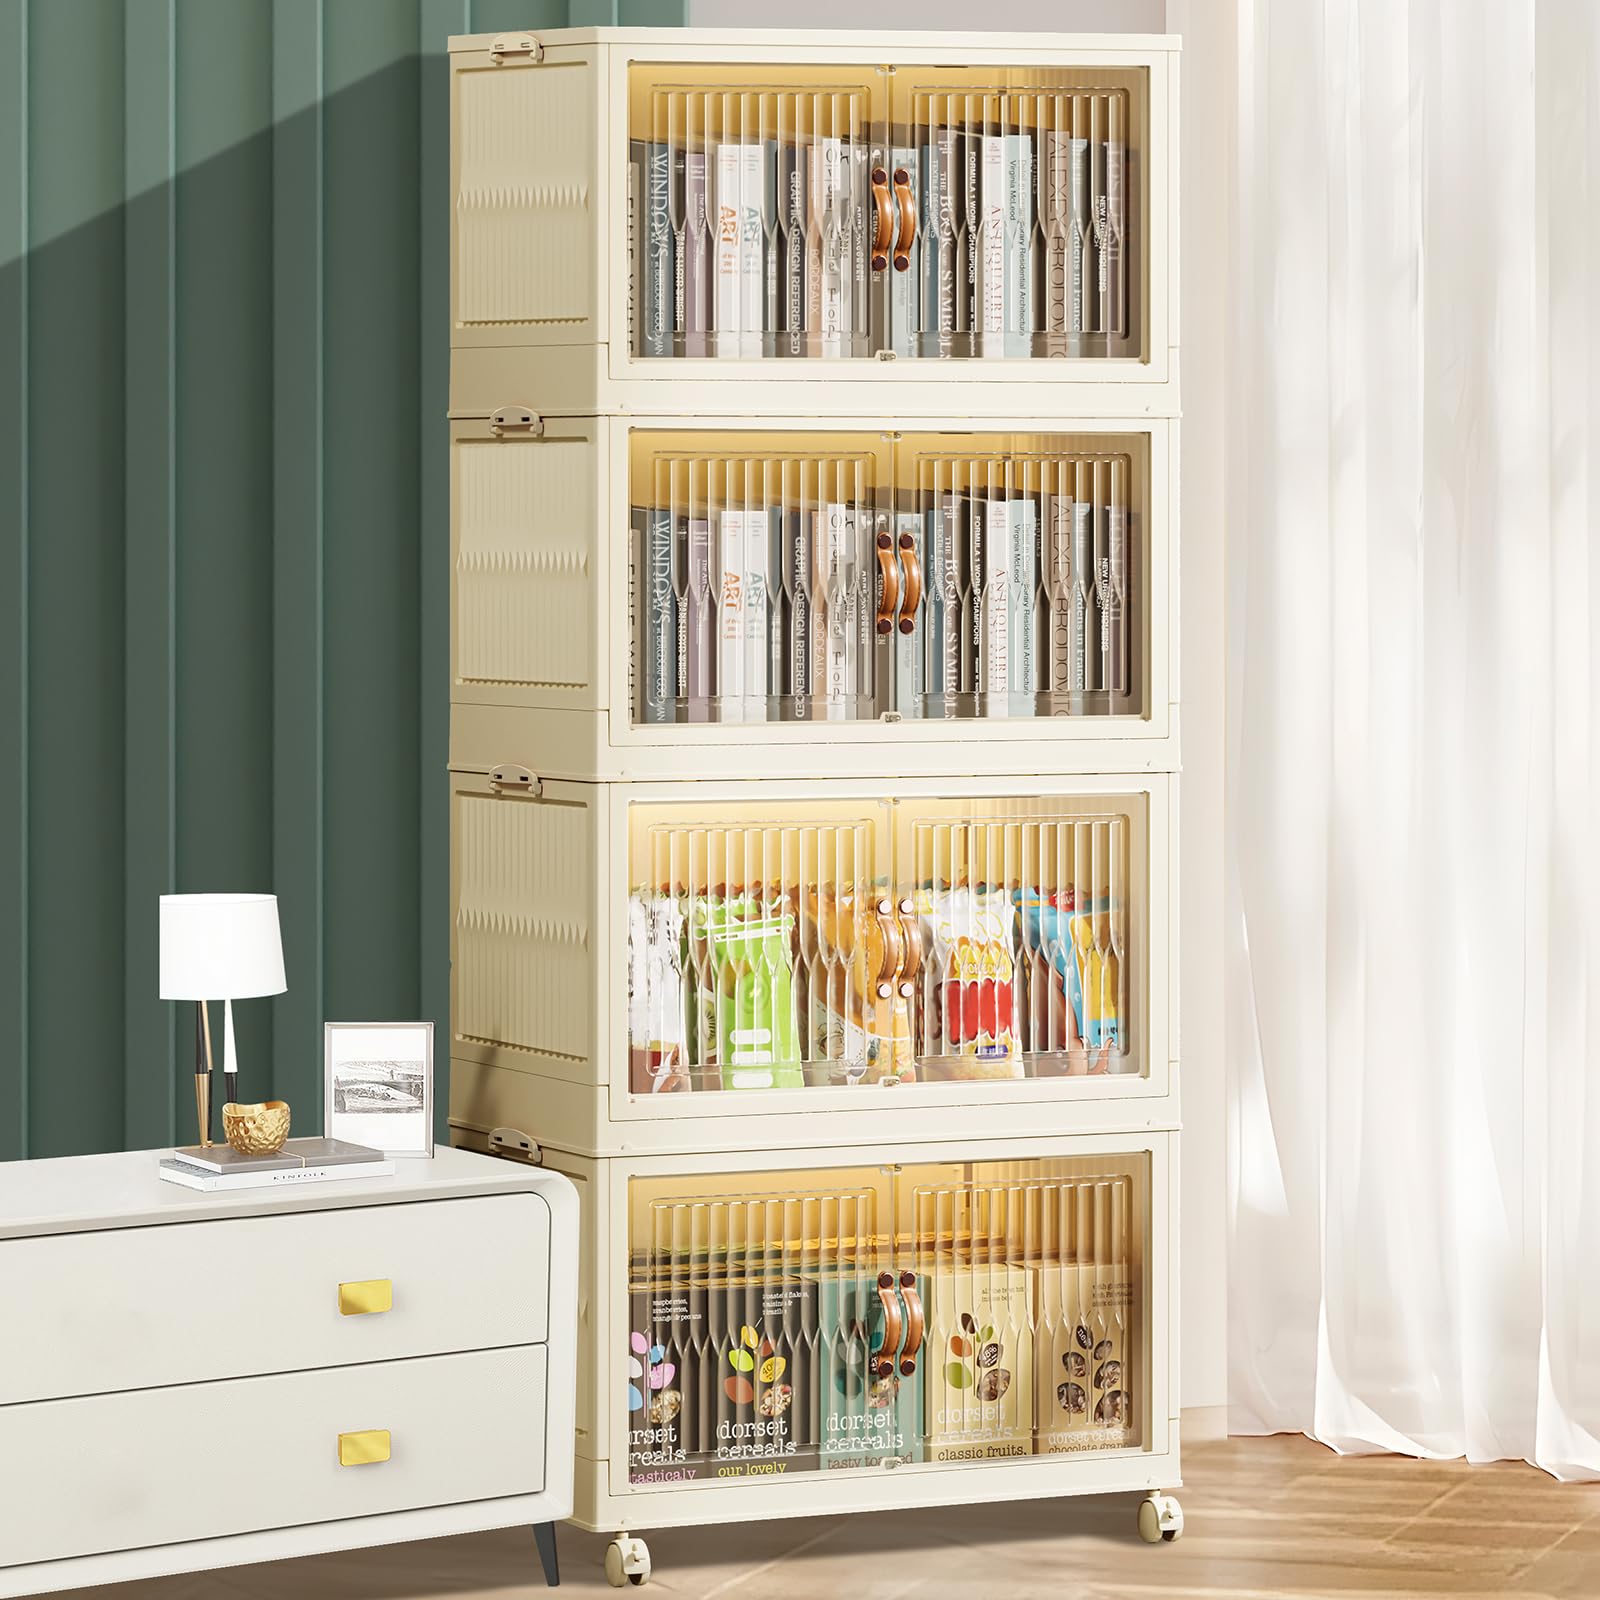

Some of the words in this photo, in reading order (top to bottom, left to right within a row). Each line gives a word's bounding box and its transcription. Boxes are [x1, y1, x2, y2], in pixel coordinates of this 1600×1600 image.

[1009, 160, 1017, 189] Virginia
[1050, 138, 1067, 229] ALEXEY
[790, 171, 801, 224] GRAPHIC
[719, 205, 738, 246] ART
[742, 205, 760, 246] ART
[791, 228, 800, 272] DESIGN
[810, 249, 820, 313] BORDEAUX
[790, 276, 800, 354] REFERENCED
[1013, 524, 1021, 552] Virginia
[1053, 501, 1071, 590] ALEXEY
[795, 536, 806, 589] GRAPHIC
[722, 571, 742, 612] ART
[746, 571, 764, 612] ART
[796, 593, 805, 637] DESIGN
[815, 613, 825, 678] BORDEAUX
[795, 640, 805, 718] REFERENCED
[716, 1417, 788, 1440] dorset
[826, 1409, 894, 1431] dorset
[937, 1405, 1006, 1424] dorset
[717, 1438, 797, 1457] cereals
[825, 1431, 904, 1450] cereals
[938, 1447, 983, 1461] classic
[986, 1444, 1028, 1457] fruits.
[1048, 1430, 1089, 1445] dorset
[718, 1465, 743, 1477] our
[746, 1461, 788, 1476] lovely
[827, 1455, 862, 1470] tasty
[865, 1452, 913, 1467] toaed
